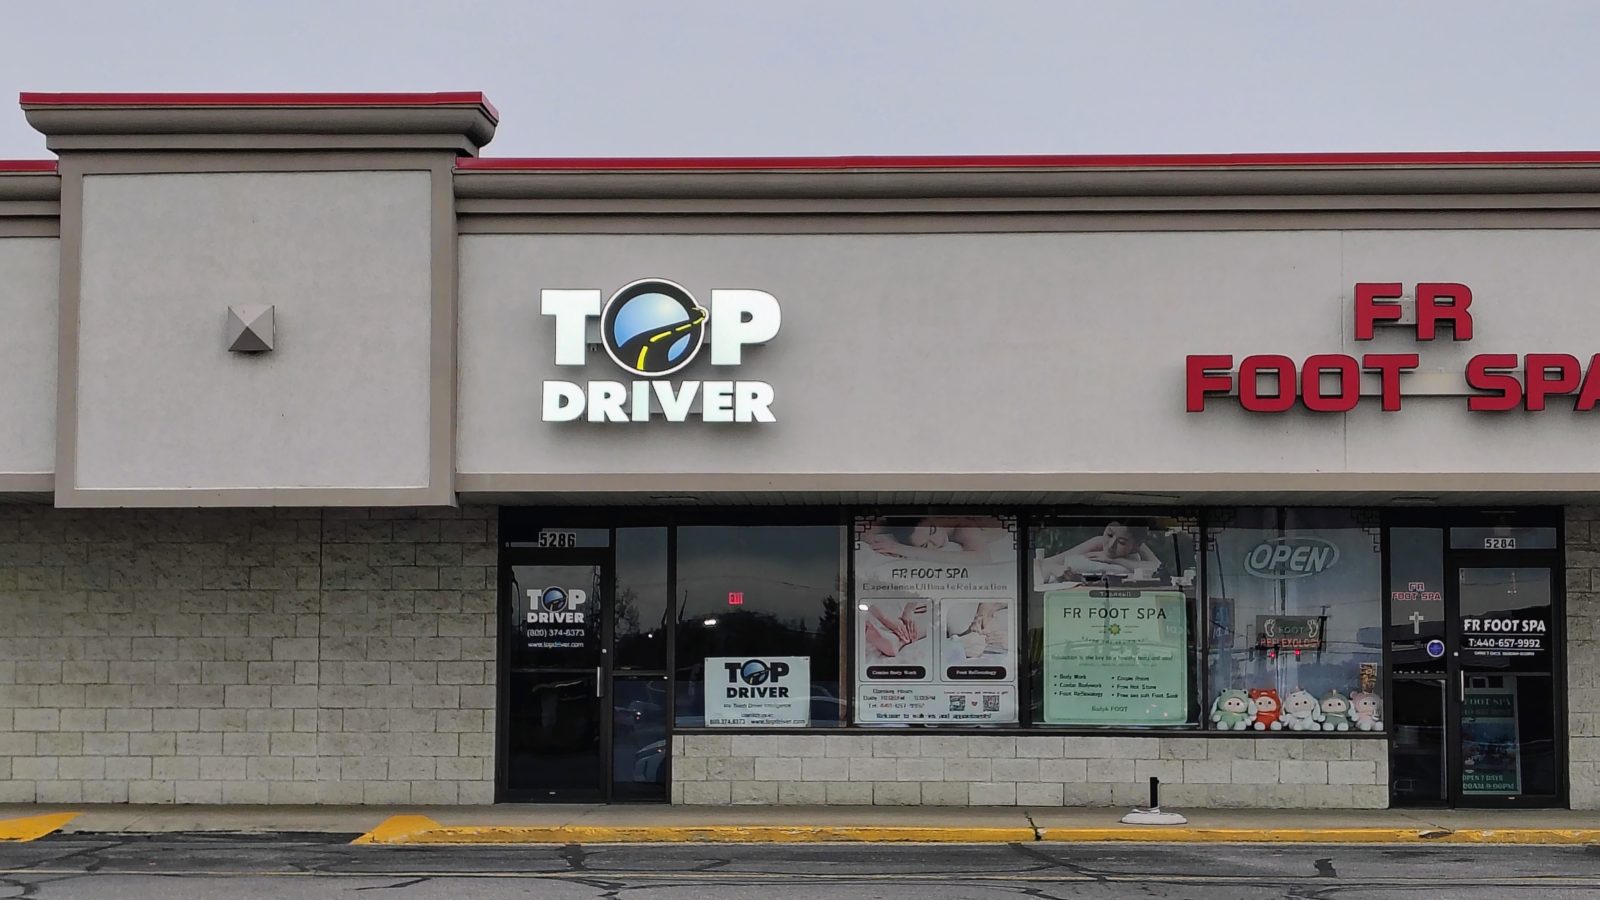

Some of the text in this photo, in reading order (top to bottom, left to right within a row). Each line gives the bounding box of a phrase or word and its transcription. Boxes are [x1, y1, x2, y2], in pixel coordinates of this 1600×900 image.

[1354, 283, 1473, 341] FR
[541, 277, 781, 376] TOP
[1186, 354, 1419, 412] FOOT
[542, 380, 777, 422] DRIVER
[540, 532, 576, 547] 5286
[1486, 538, 1515, 549] 5284
[1250, 544, 1330, 573] OPEN
[891, 568, 969, 579] FR FOOT SPA
[526, 586, 587, 613] TOP
[1421, 592, 1442, 601] SPA
[526, 612, 585, 624] DRIVER
[1063, 607, 1167, 620] FR FOOT SPA
[1464, 619, 1546, 632] FR FOOT SPA
[1468, 638, 1541, 648] T:440-657-9992
[724, 659, 790, 686] TOP
[726, 687, 789, 698] DRIVER
